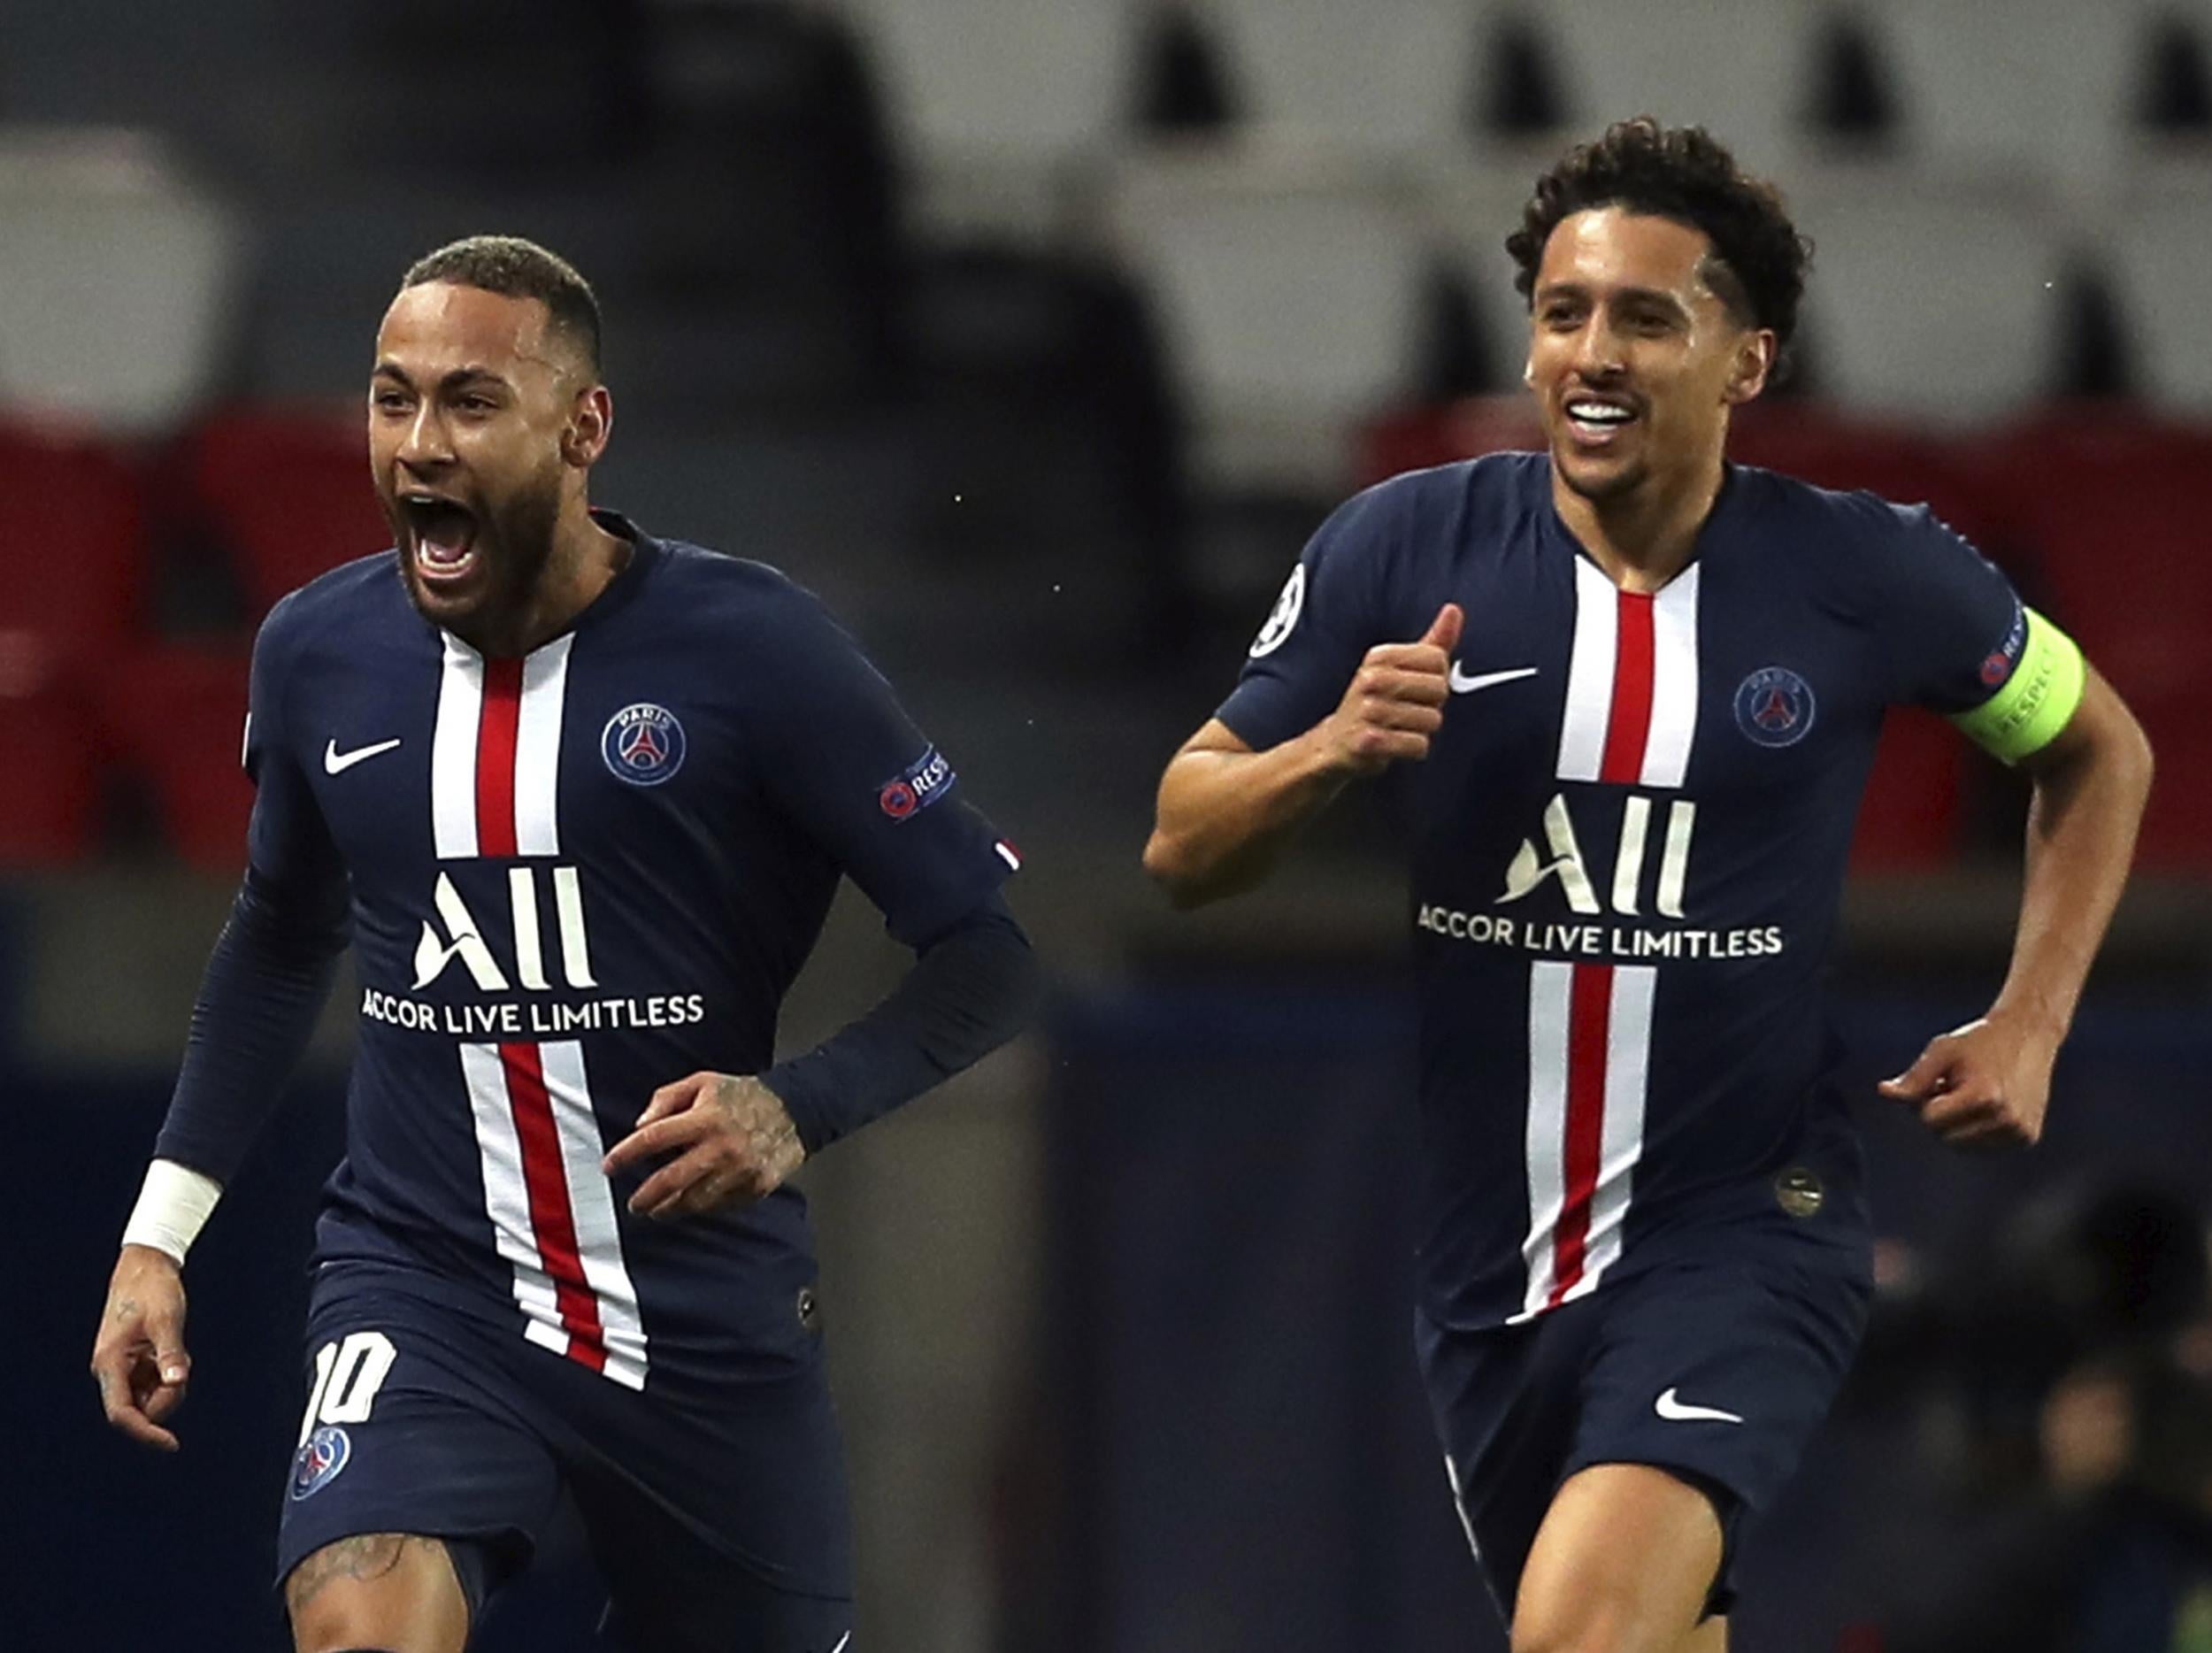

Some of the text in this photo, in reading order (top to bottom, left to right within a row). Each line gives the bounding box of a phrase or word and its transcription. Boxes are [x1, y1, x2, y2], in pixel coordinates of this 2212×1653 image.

[1417, 903, 1783, 958] ACCOR LIVE LIMITLESS
[362, 988, 703, 1034] ACCOR LIVE LIMITLESS
[298, 1332, 397, 1448] 10
